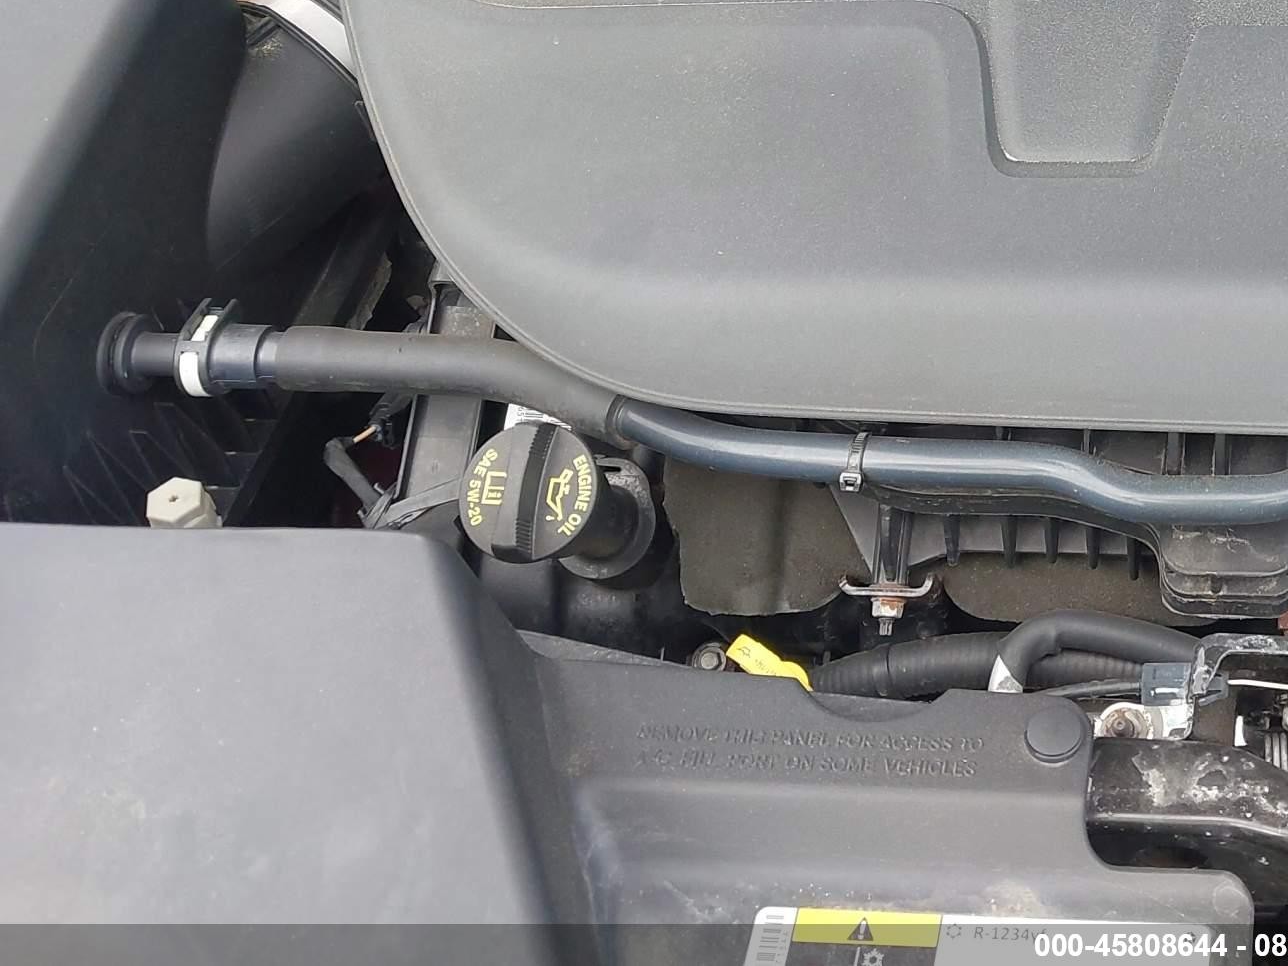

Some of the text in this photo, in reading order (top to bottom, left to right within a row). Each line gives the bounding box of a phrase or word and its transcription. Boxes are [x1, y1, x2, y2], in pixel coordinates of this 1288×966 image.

[467, 448, 498, 527] SAE 5W-20
[557, 454, 592, 537] ENGINE OIL
[637, 723, 985, 753] REMOVE THIS PANEL FOR ACCESS TO
[725, 752, 777, 771] PORT
[784, 754, 816, 772] ON
[819, 755, 874, 774] SOME
[883, 757, 977, 778] VEHICLES
